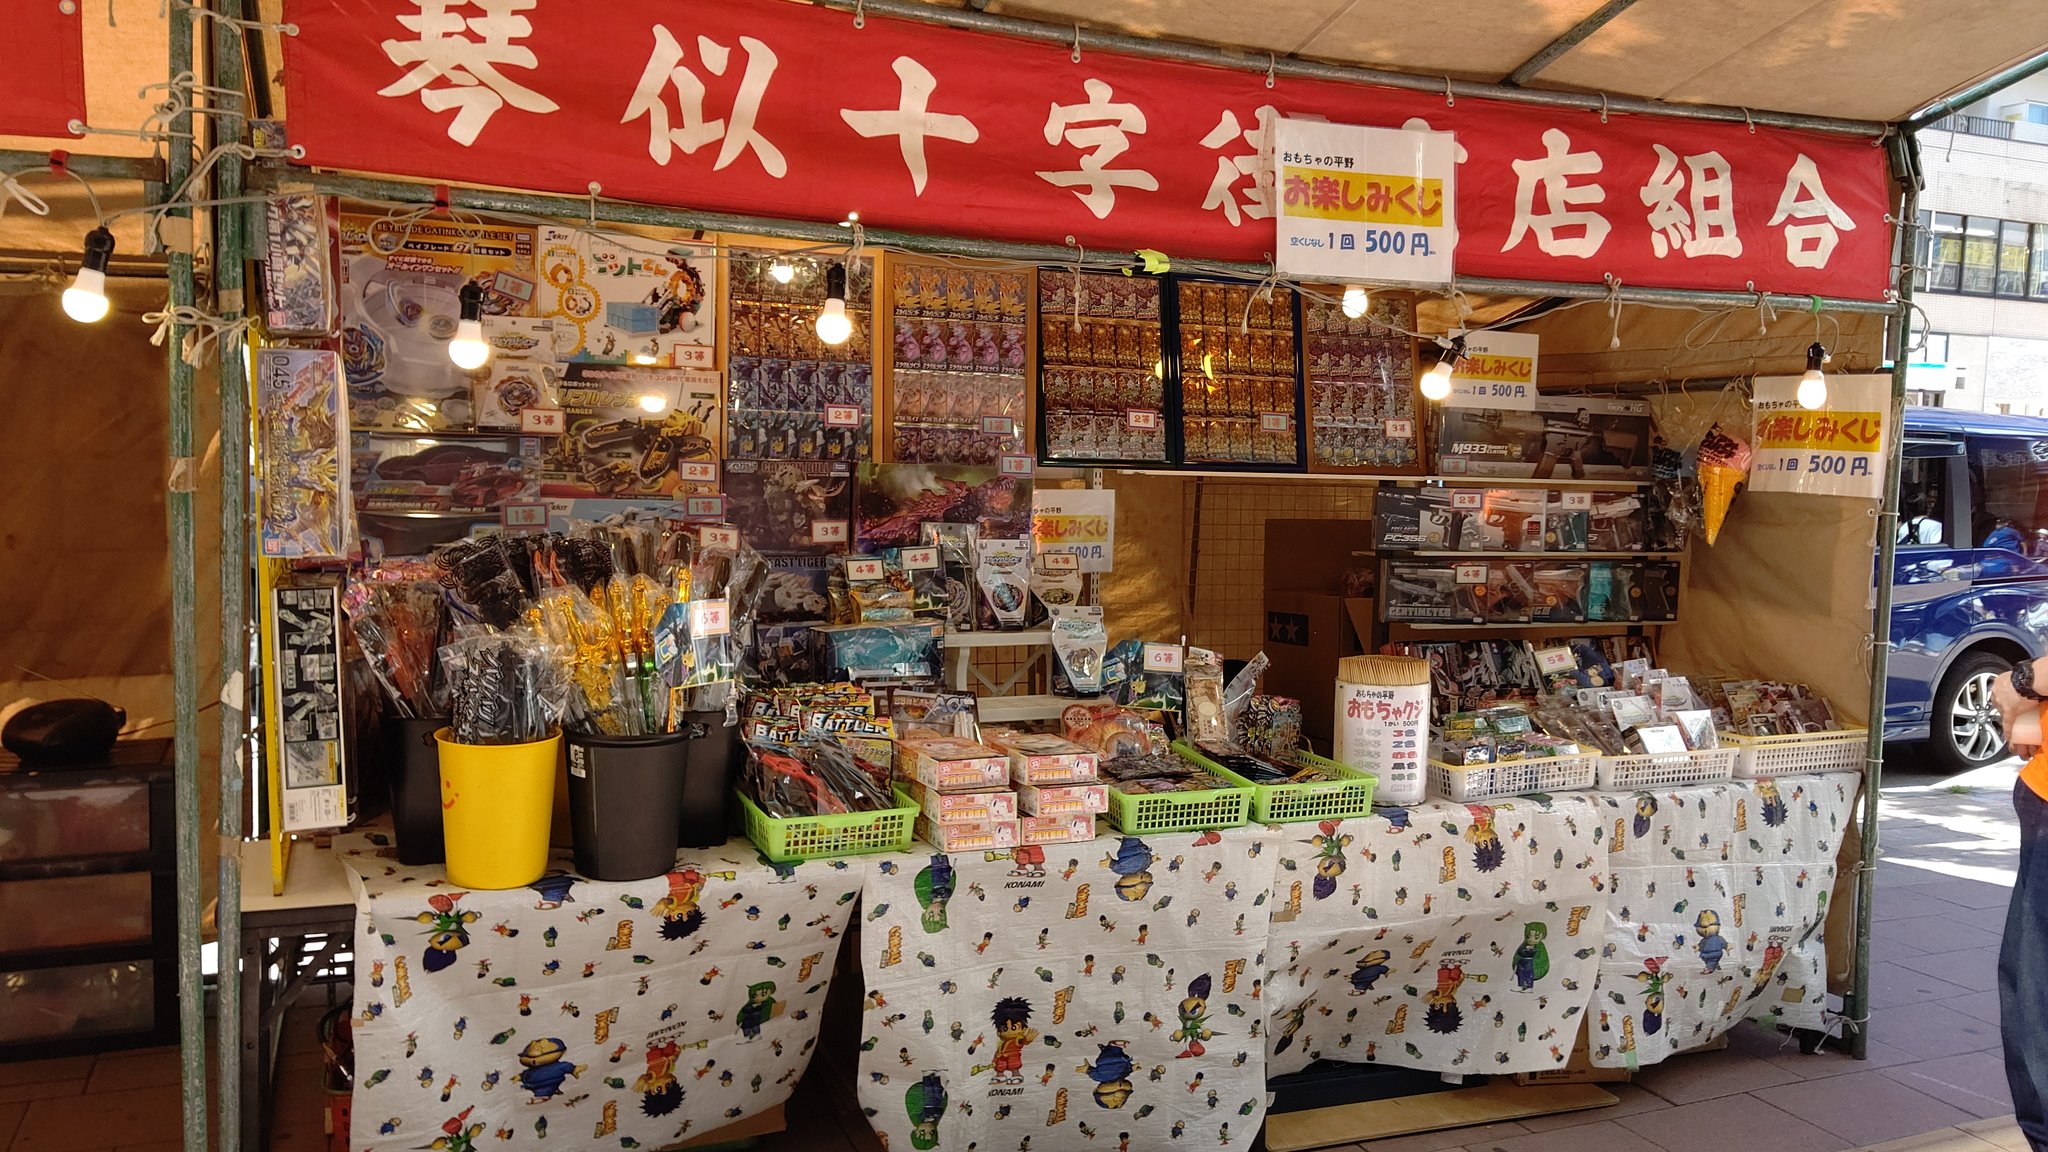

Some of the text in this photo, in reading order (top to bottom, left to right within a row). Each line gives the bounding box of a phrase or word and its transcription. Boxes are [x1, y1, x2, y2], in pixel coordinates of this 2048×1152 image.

[378, 0, 1857, 269] 琴似十字街店組合
[1283, 151, 1354, 169] おもちゃの平野
[1284, 175, 1442, 217] お楽しみくじ
[377, 223, 423, 235] BEYBLADE
[1290, 236, 1324, 248] 空くじなし
[1329, 232, 1355, 250] 1回
[683, 349, 705, 362] 3等
[272, 355, 290, 389] 045
[1758, 400, 1805, 409] おもちゃの平
[532, 414, 555, 426] 3等
[834, 410, 853, 421] 2等
[1134, 415, 1150, 425] 2等
[1756, 416, 1880, 444] お楽しみくじ
[1451, 444, 1487, 454] M933
[807, 462, 829, 473] BULL
[1779, 458, 1799, 471] 1回
[1808, 455, 1869, 476] 500円
[689, 466, 711, 477] 2等
[1458, 495, 1476, 505] 2等
[1568, 496, 1586, 505] 3等
[693, 501, 714, 513] 1等
[513, 508, 536, 524] 1等
[821, 527, 840, 537] 3等
[1041, 518, 1108, 538] 楽しみくじ
[709, 532, 730, 543] 3等
[797, 557, 827, 568] LIGER
[910, 552, 930, 564] 4等
[1052, 556, 1071, 565] 4等
[856, 564, 876, 575] 4等
[1463, 569, 1480, 578] 4等
[1389, 607, 1451, 616] CENTIMETER
[1154, 652, 1173, 664] 6等
[1547, 654, 1566, 666] 5等
[1347, 699, 1423, 720] おもちゃクジ
[812, 713, 889, 735] BATTLER
[1392, 751, 1417, 759] 赤色
[1004, 881, 1045, 889] KONAMI
[987, 1088, 1024, 1098] KONAMI
